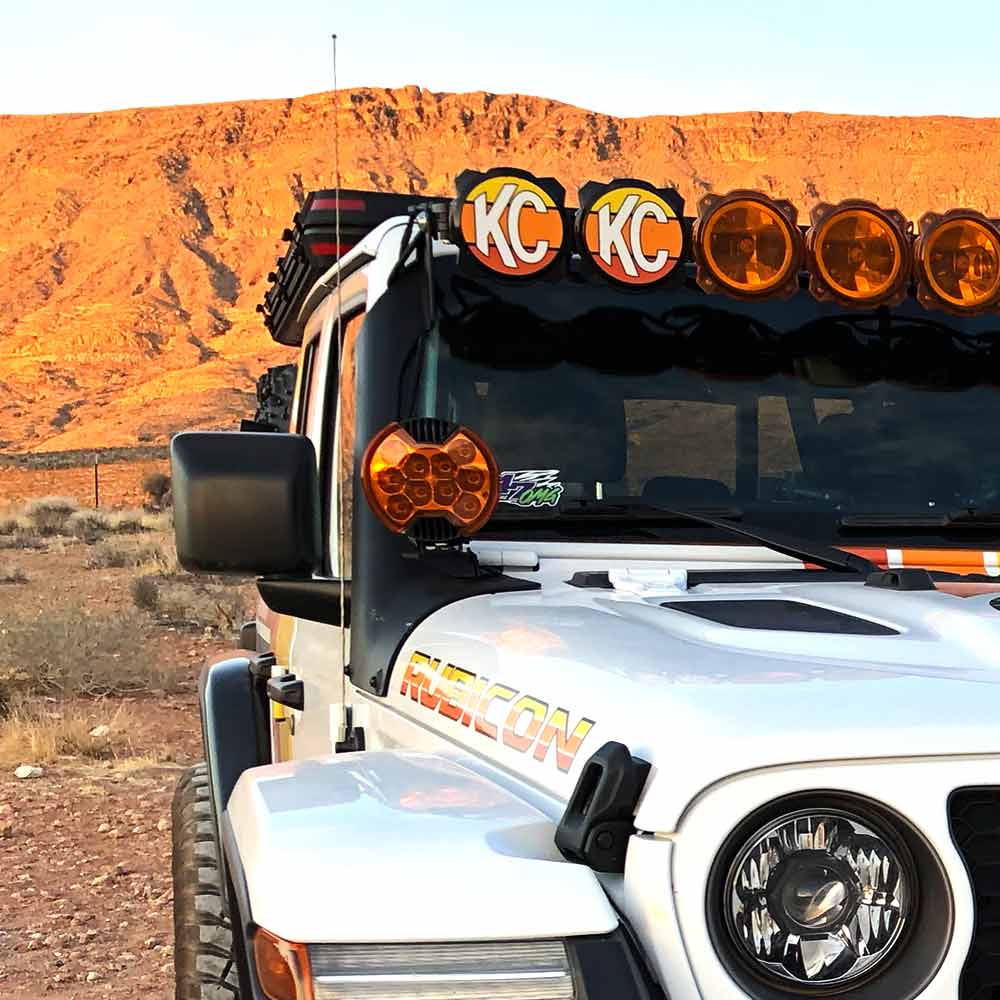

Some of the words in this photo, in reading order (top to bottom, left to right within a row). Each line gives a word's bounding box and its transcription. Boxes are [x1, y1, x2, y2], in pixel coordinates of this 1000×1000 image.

[473, 183, 549, 269] KC
[598, 194, 669, 277] KC
[400, 650, 597, 774] RUBICON
